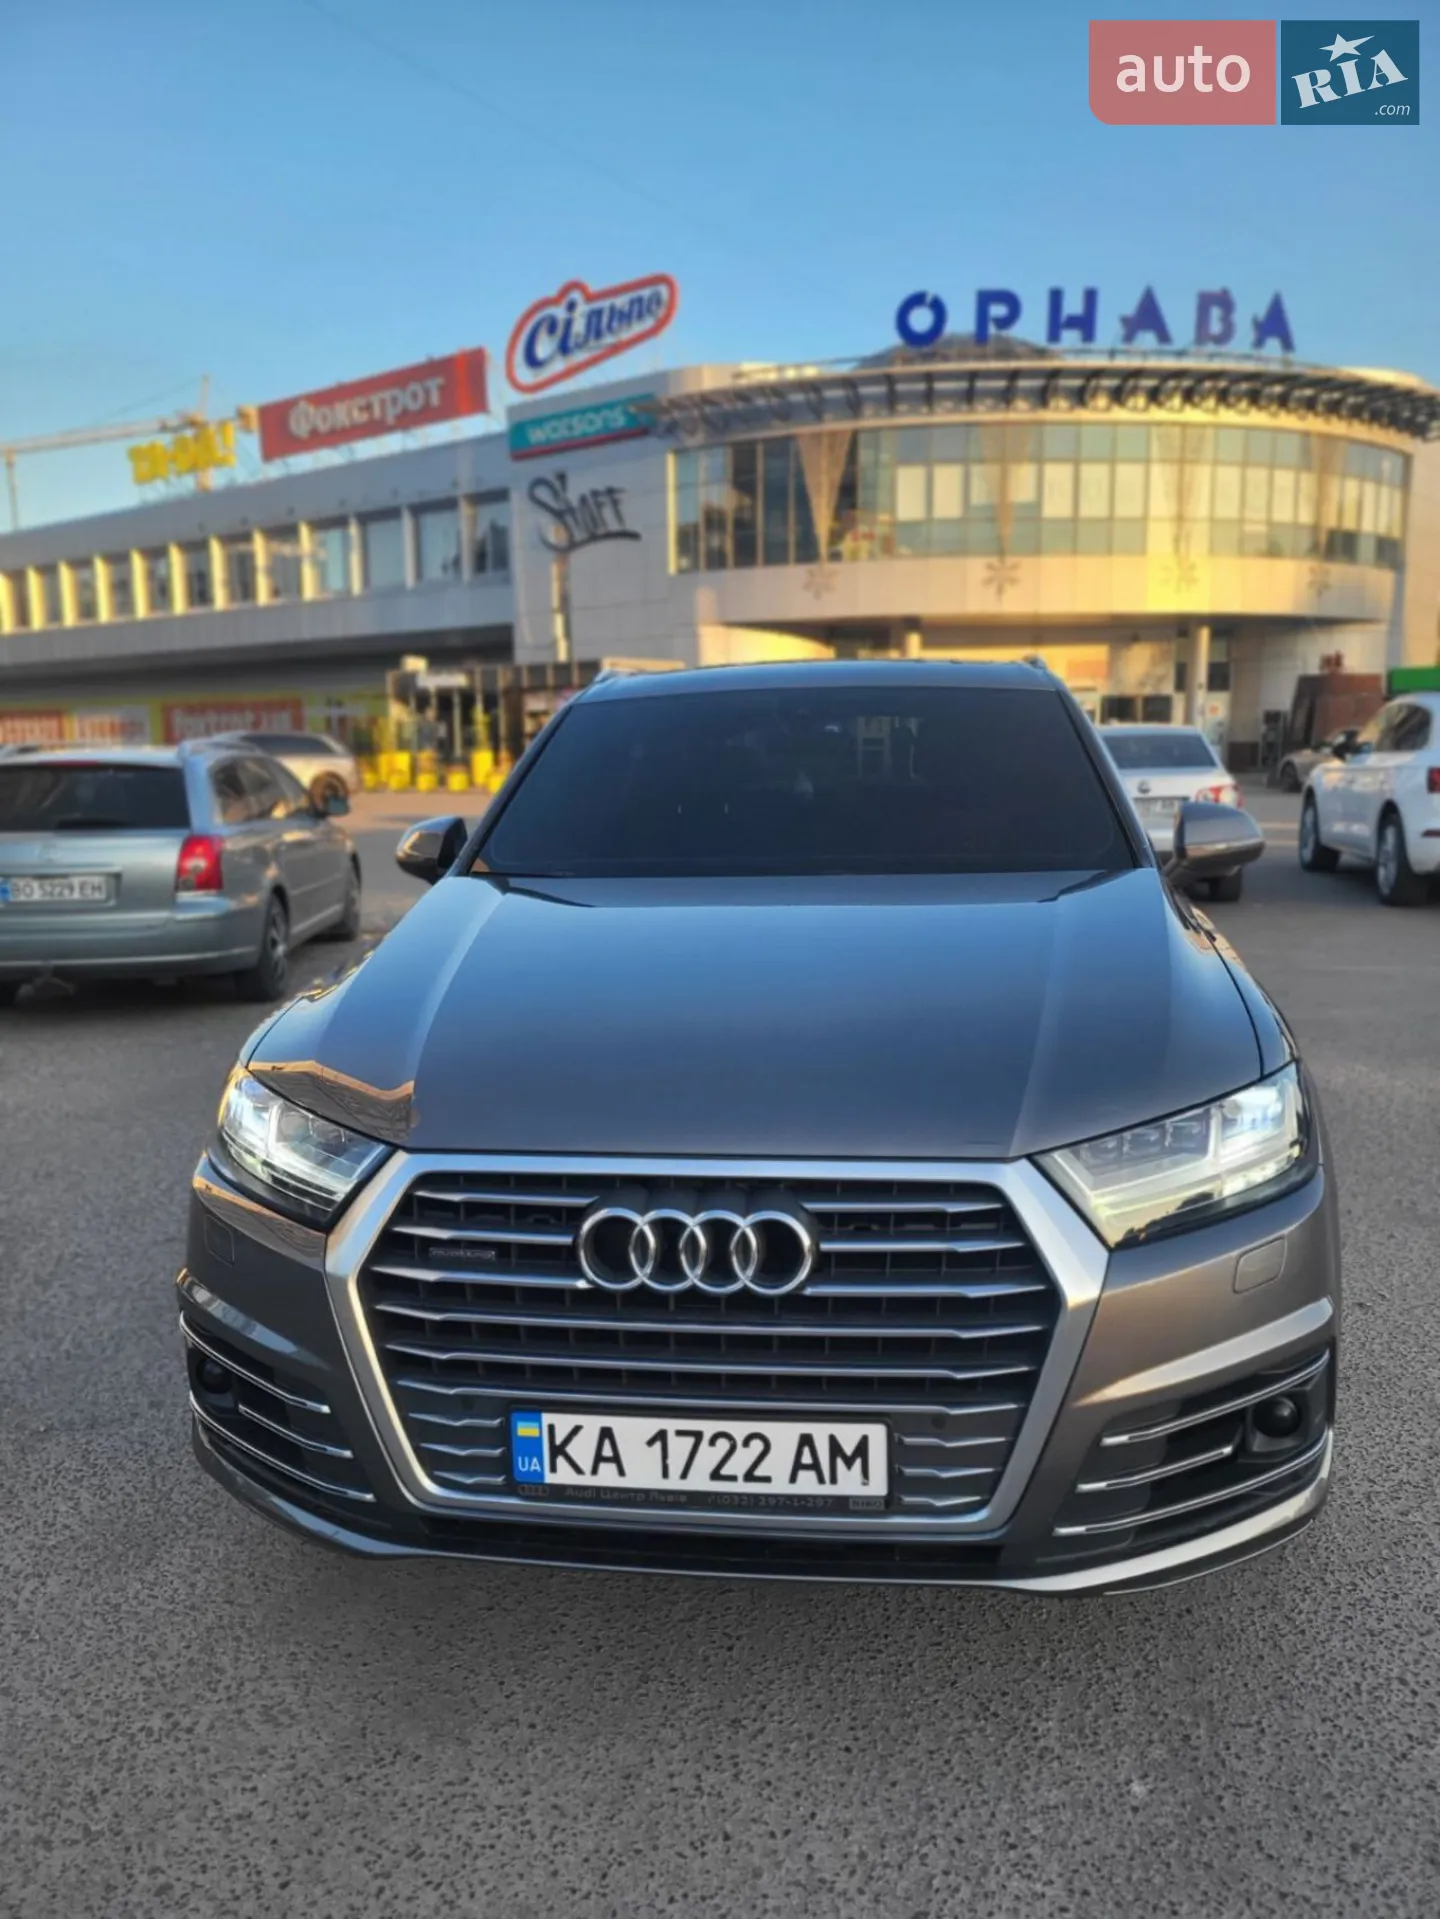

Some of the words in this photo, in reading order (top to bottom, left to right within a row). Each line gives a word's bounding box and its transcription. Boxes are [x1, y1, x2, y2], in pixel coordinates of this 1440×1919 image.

[524, 288, 663, 370] Сільпо
[895, 285, 1295, 353] ОРНАВА
[289, 376, 445, 440] Фокстрот
[517, 1456, 542, 1473] UA
[547, 1423, 626, 1478] KA
[645, 1428, 772, 1484] 1722
[789, 1432, 870, 1487] AM
